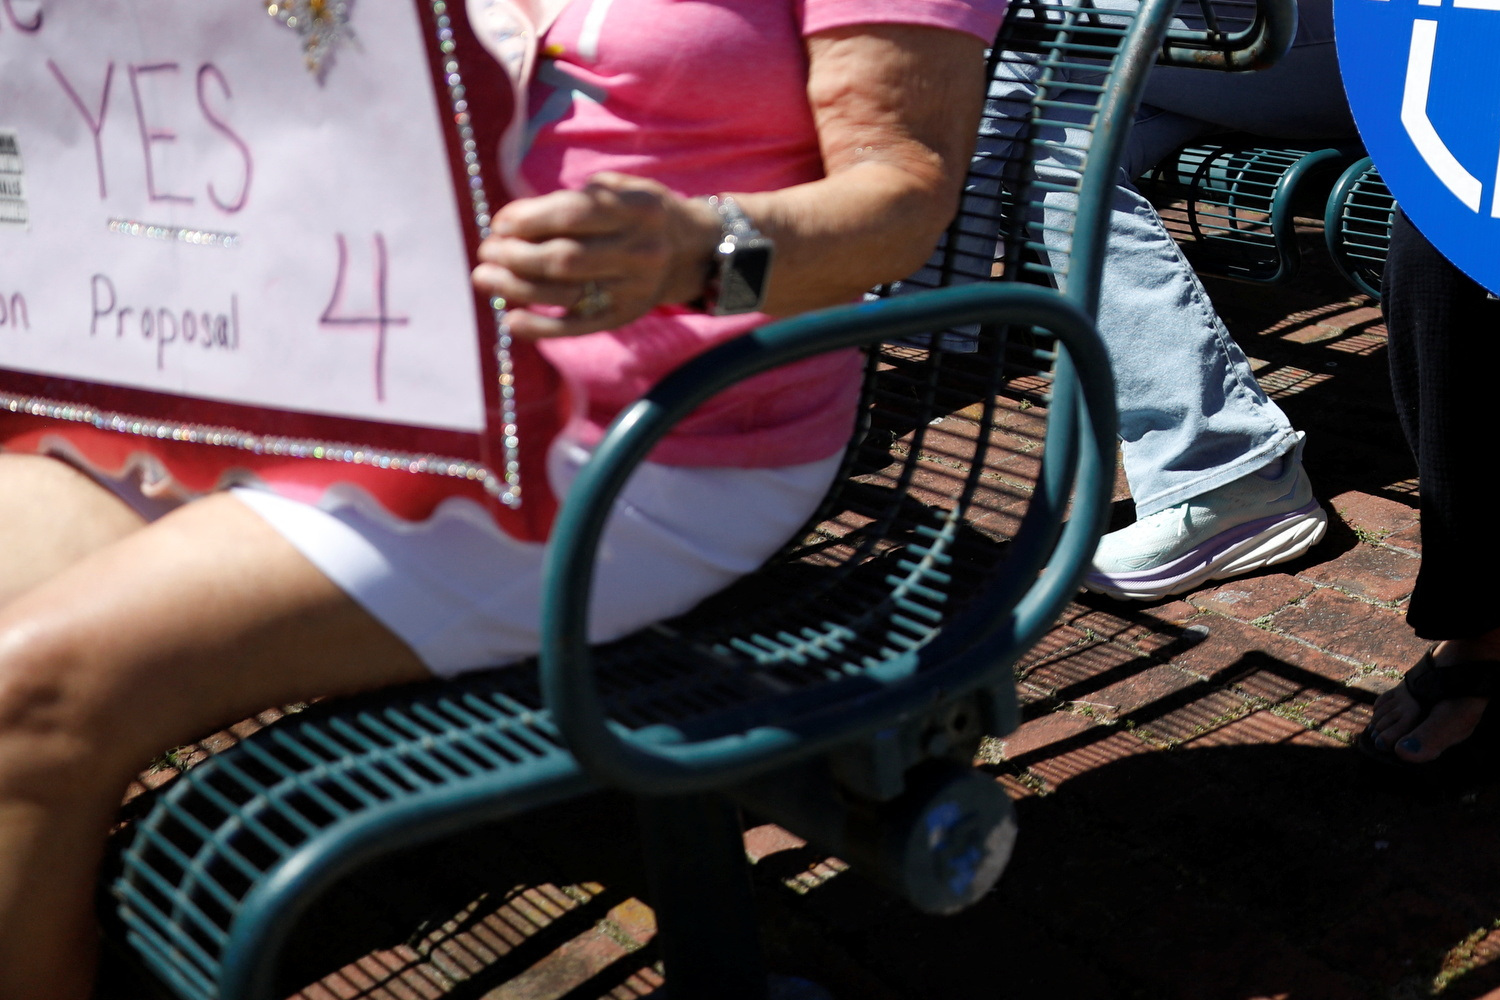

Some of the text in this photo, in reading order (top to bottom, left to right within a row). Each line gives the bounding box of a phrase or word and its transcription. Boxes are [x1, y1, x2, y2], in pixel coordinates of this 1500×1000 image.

[48, 56, 255, 214] YES
[90, 273, 242, 370] Proposal
[319, 232, 410, 402] 4
